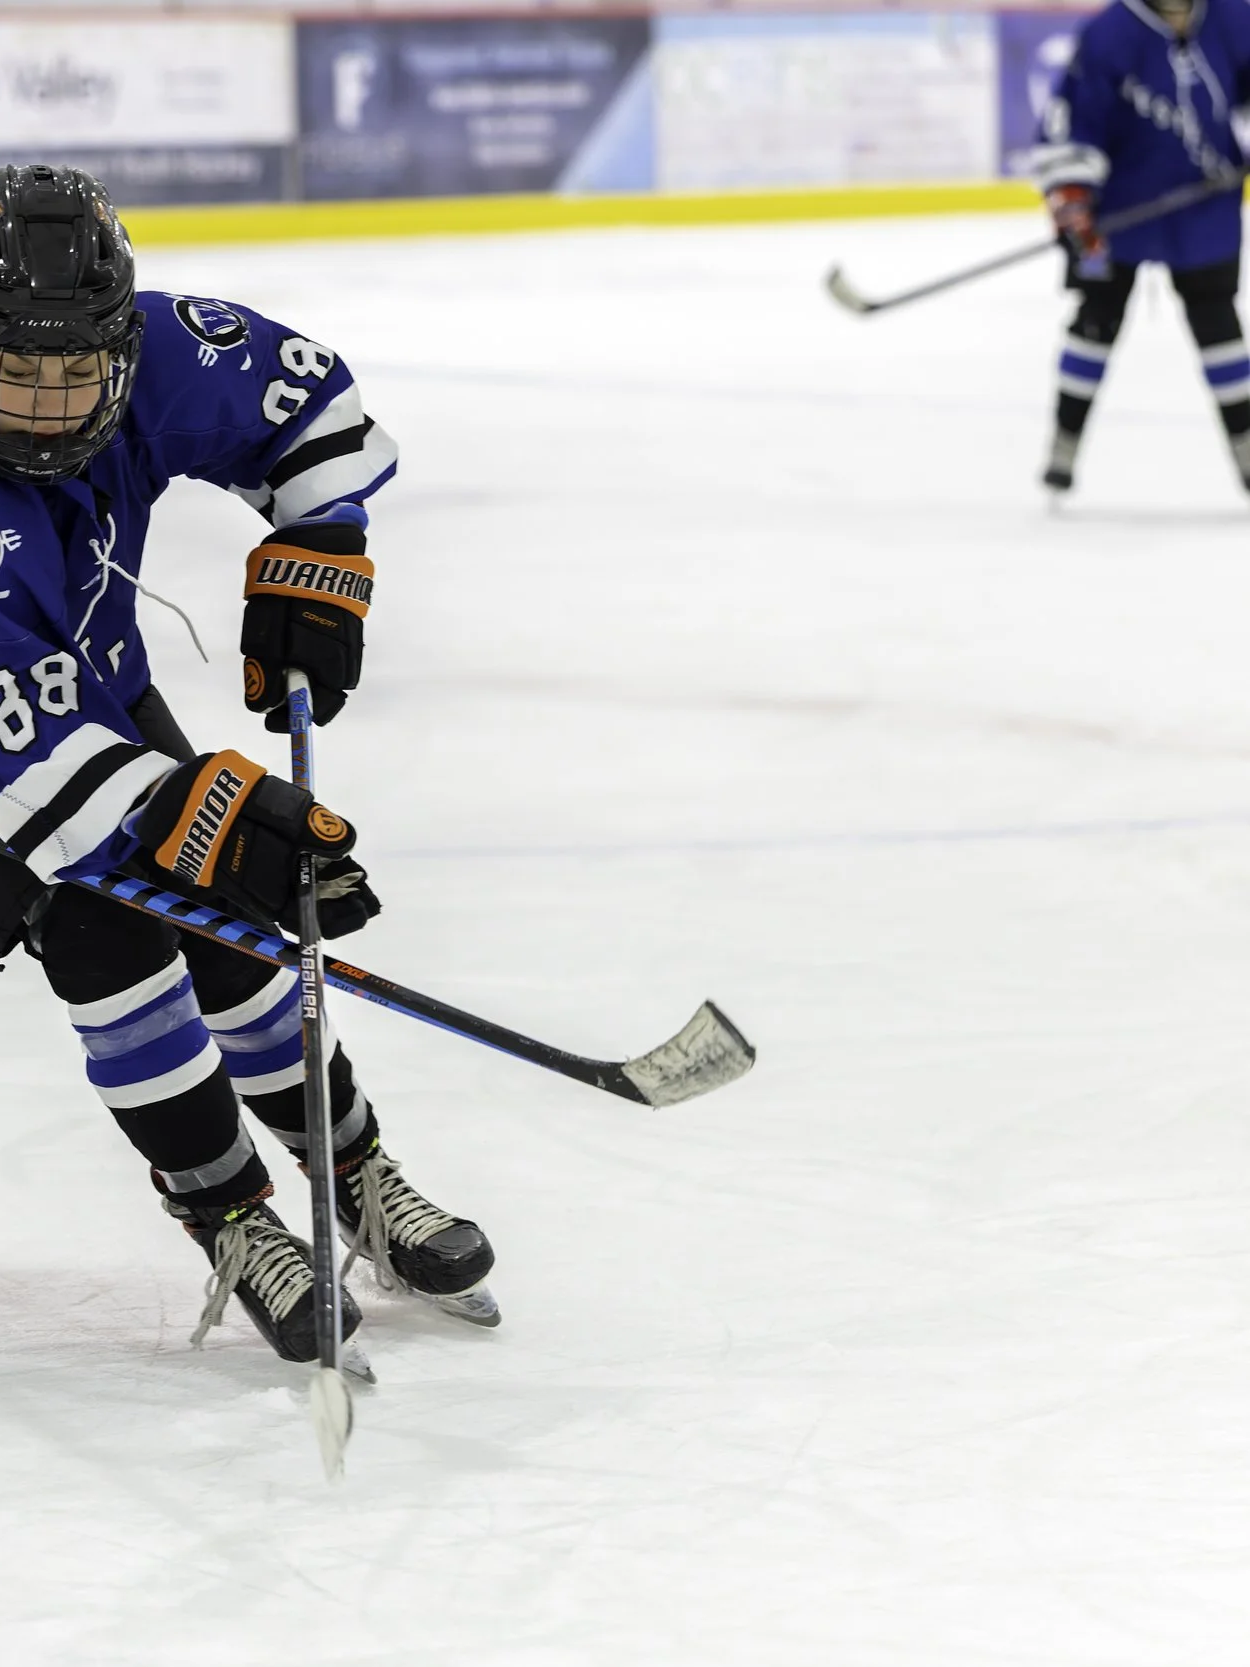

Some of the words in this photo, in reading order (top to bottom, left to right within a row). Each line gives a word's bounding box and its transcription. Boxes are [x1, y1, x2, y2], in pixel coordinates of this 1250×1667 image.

[255, 557, 374, 606] WARRIO
[302, 611, 339, 629] COVERT
[291, 732, 309, 790] SYN
[230, 833, 246, 873] COVERT
[301, 957, 318, 1019] BAUER
[329, 961, 370, 981] EDGE
